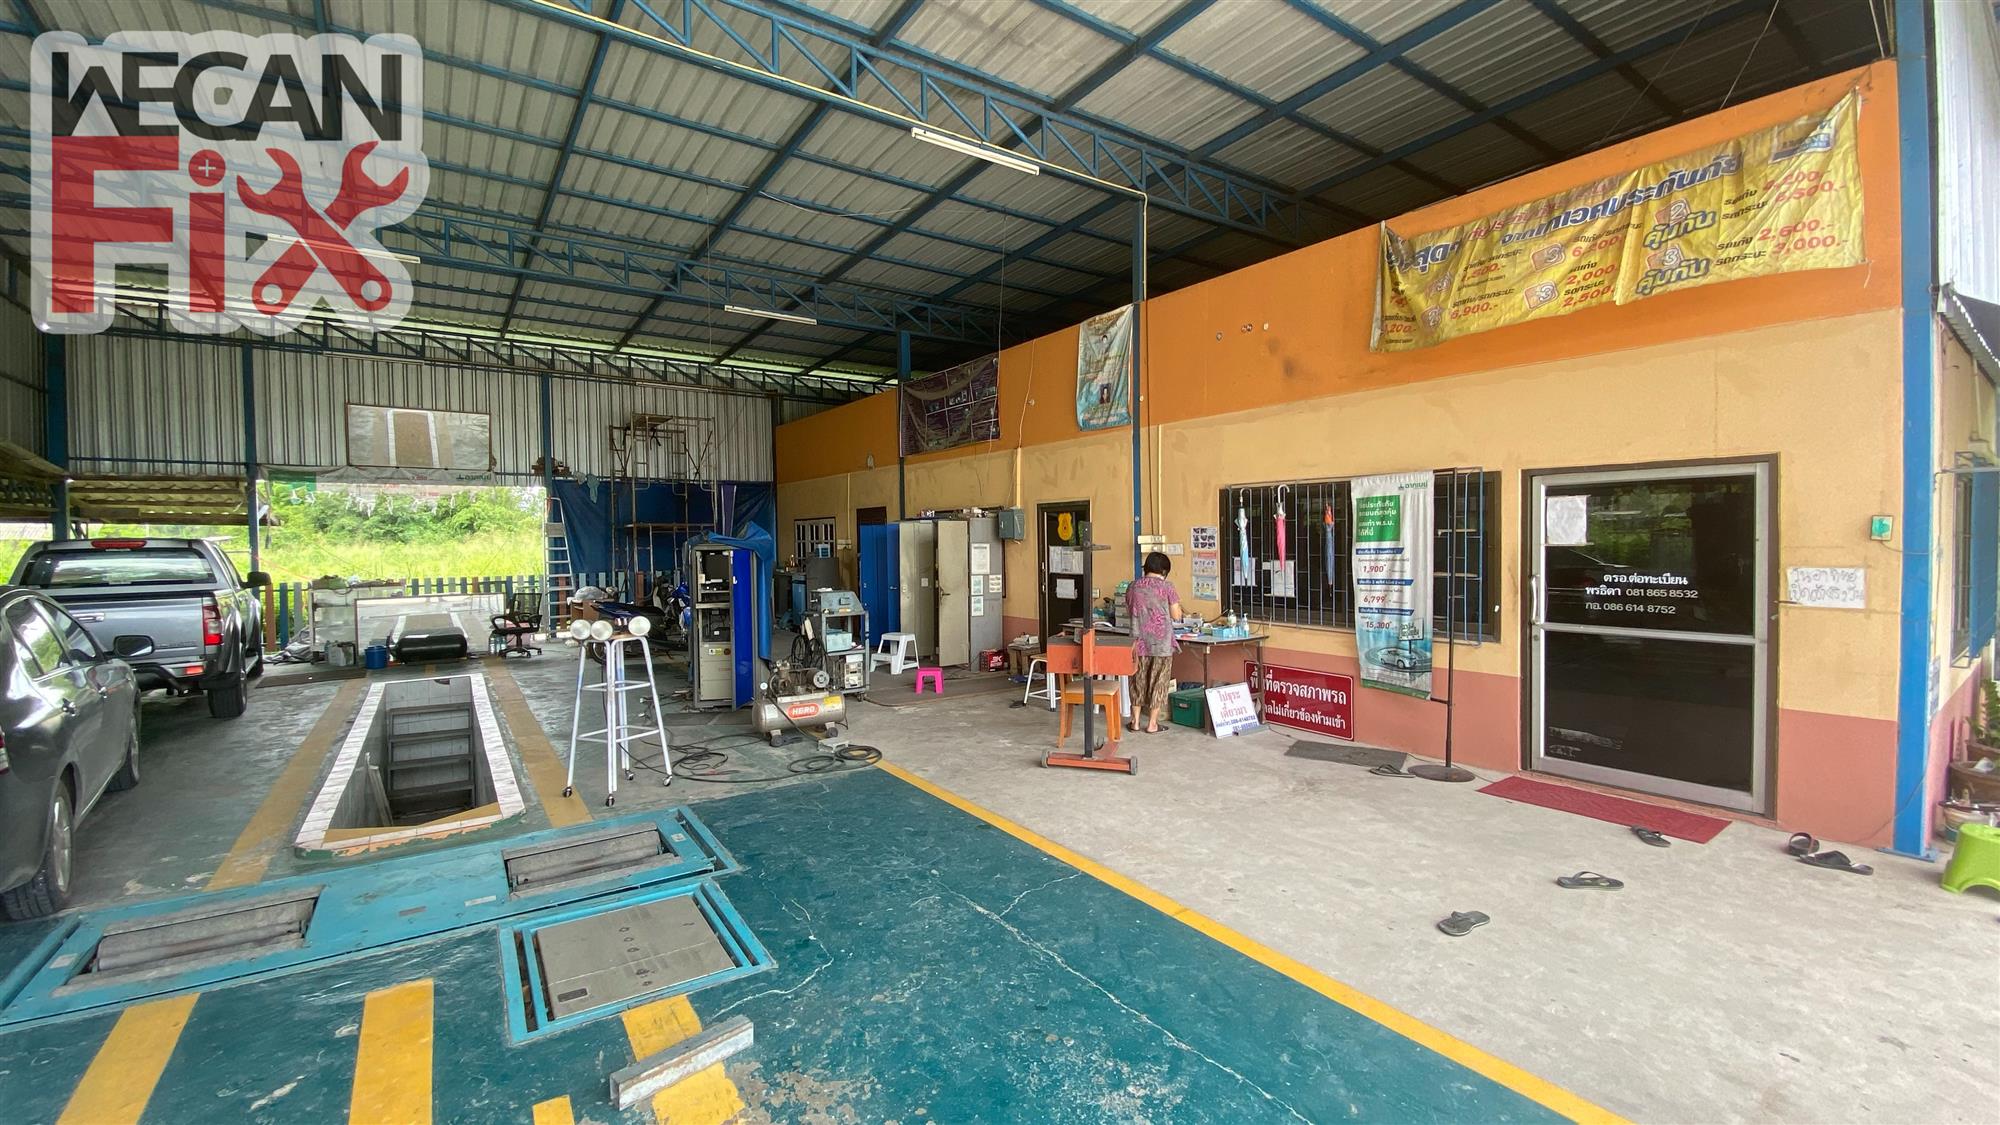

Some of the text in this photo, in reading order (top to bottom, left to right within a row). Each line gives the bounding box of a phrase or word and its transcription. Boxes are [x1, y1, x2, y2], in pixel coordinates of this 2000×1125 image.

[1626, 588, 1644, 597] 081
[1646, 588, 1667, 597] 865
[1669, 589, 1698, 599] 8532
[1603, 602, 1623, 611] 086
[1625, 603, 1645, 612] 614
[1647, 604, 1676, 614] 8752
[1249, 665, 1347, 705] พื้ที่ตรวจสภาพรถ
[792, 706, 815, 715] HERO
